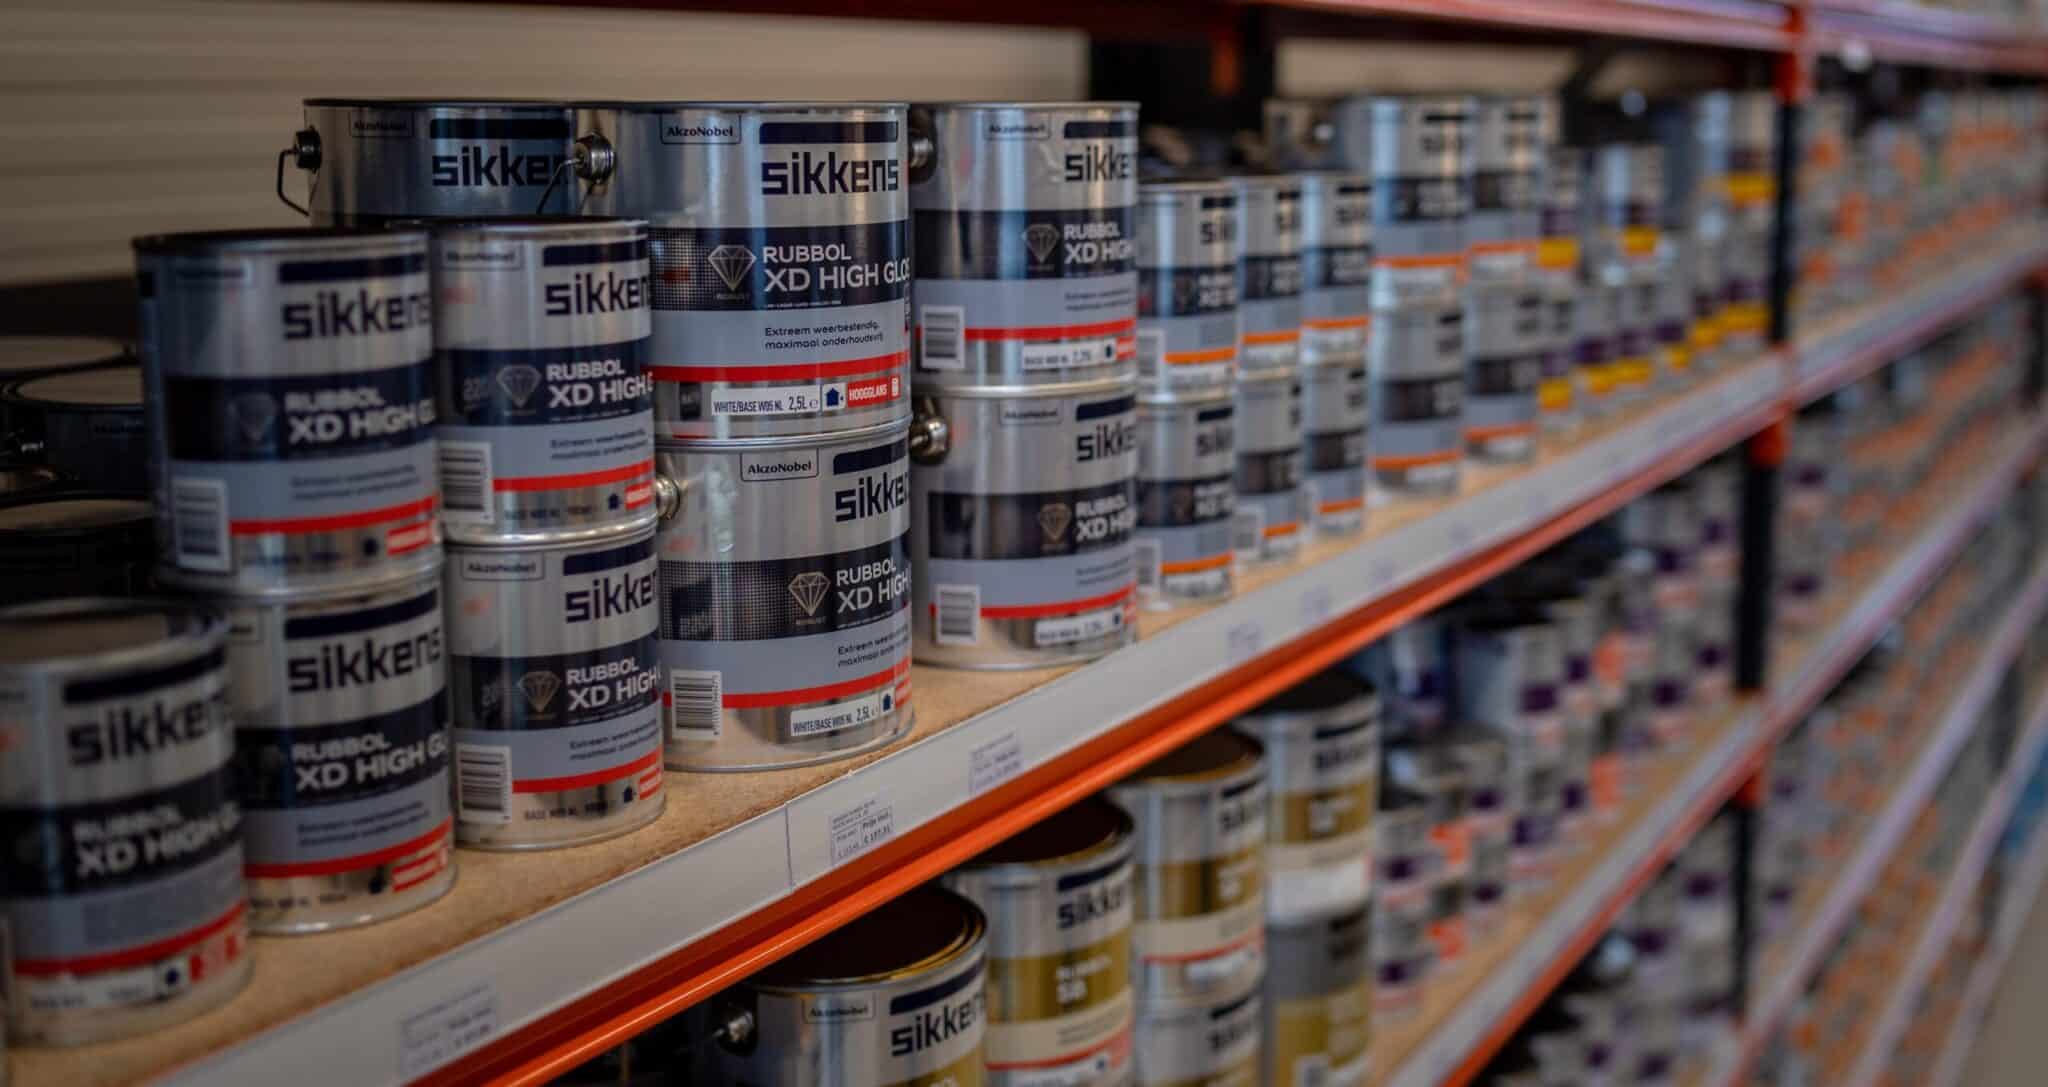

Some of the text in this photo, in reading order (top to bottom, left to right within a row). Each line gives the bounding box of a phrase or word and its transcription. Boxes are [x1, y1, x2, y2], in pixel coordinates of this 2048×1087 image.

[667, 126, 734, 138] AkzoNobel
[761, 151, 899, 195] sikkens
[763, 244, 852, 264] RUBBOL
[1064, 243, 1099, 265] XD
[764, 267, 811, 293] XD
[819, 263, 880, 291] HIGH
[764, 326, 811, 338] Extreem
[764, 338, 821, 350] maximaal
[546, 358, 626, 382] RUBBOL
[549, 382, 594, 410] XD
[599, 375, 646, 405] HIGH
[788, 395, 807, 416] 2,5L
[288, 414, 345, 445] XD
[748, 461, 812, 474] AkzoNobel
[836, 559, 897, 587] RUBBOL
[837, 587, 874, 614] XD
[566, 656, 640, 686] RUBBOL
[567, 666, 658, 712] XD HIGH
[295, 762, 348, 792] XD
[356, 742, 425, 783] HIGH
